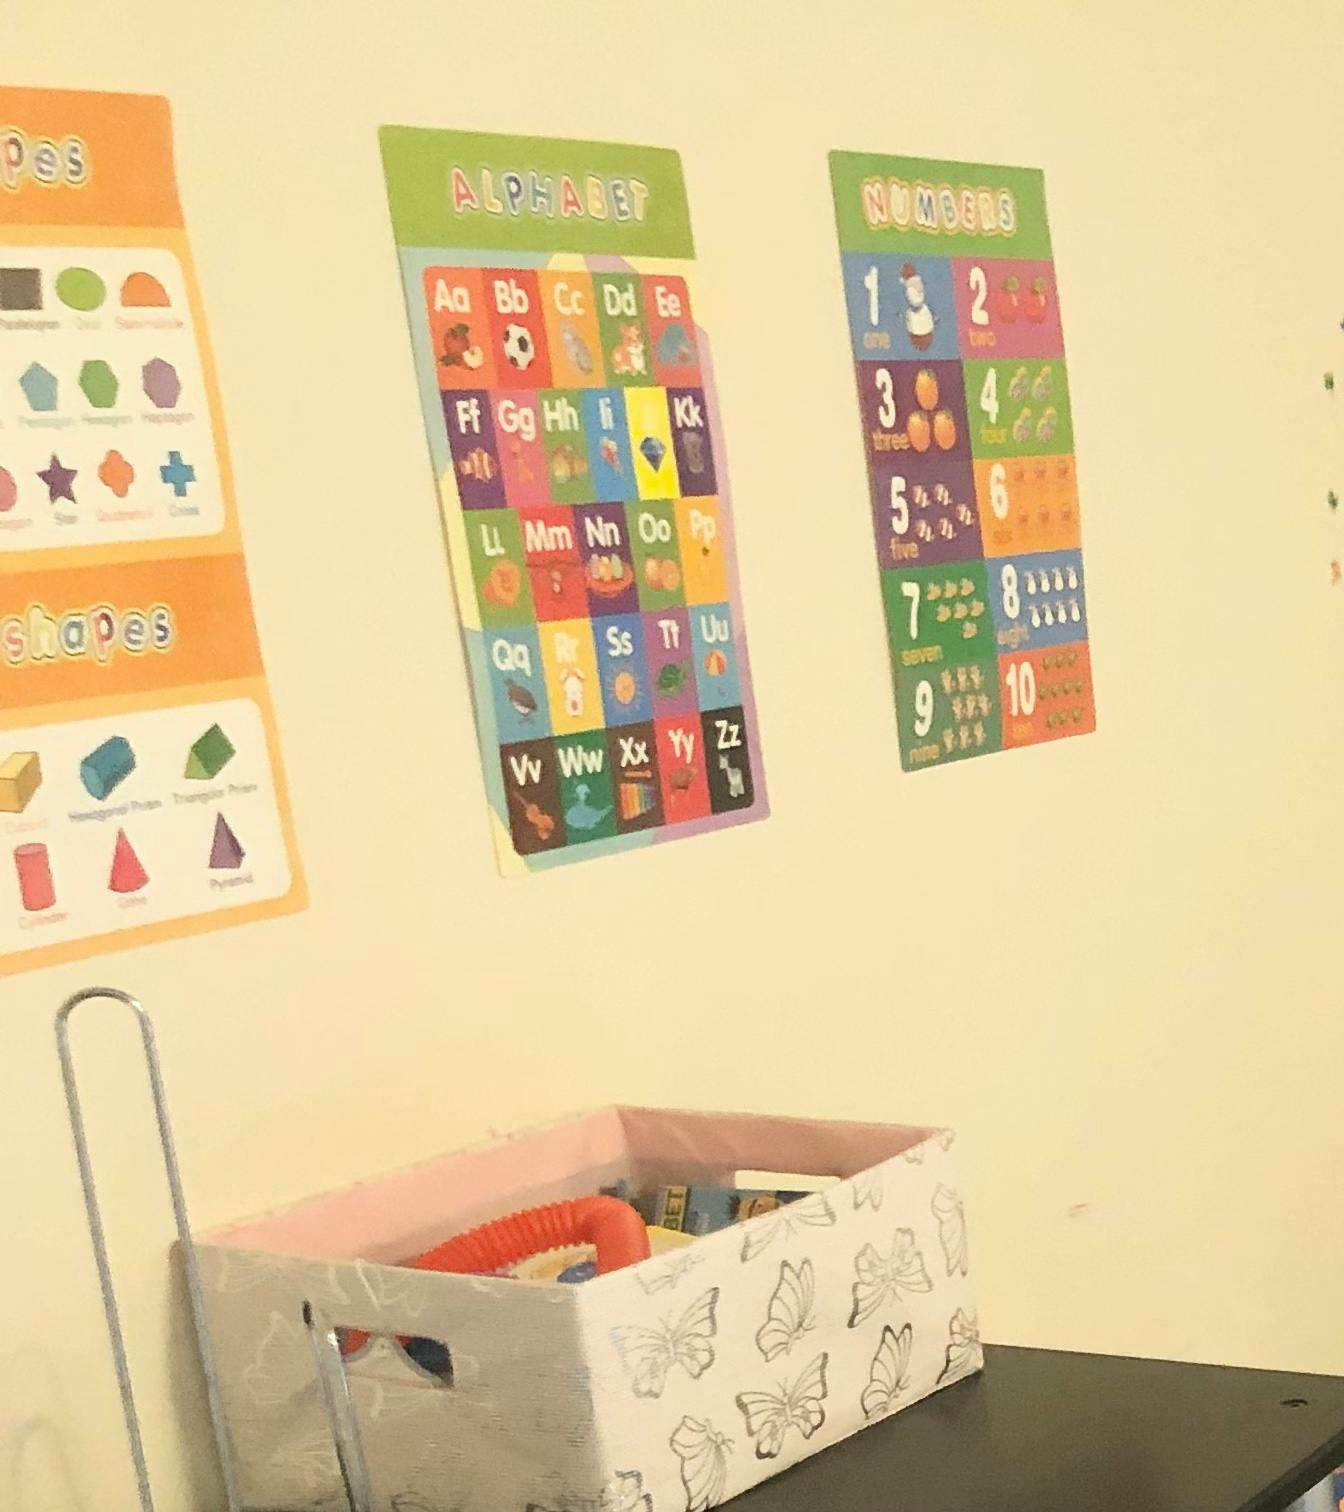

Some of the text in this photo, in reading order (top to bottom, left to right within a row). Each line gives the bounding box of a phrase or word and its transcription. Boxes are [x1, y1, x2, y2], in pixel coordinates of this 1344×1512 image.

[452, 167, 648, 221] ALPHABET
[863, 182, 1015, 232] NUMBERS
[434, 278, 681, 318] Aa Bb Cc Dd Ee
[864, 265, 879, 327] 1
[968, 266, 990, 326] 2
[456, 397, 481, 434] Ff
[498, 400, 536, 441] Gg
[541, 397, 580, 432] Hh
[674, 396, 704, 428] Kk
[875, 367, 896, 428] 3
[980, 367, 999, 424] 4
[890, 476, 909, 535] 5
[990, 463, 1009, 519] 6
[524, 520, 573, 552] Mm
[584, 516, 621, 548] Nn
[638, 512, 671, 543] Oo
[688, 508, 716, 544] Pp
[901, 582, 920, 640] 7
[1001, 564, 1020, 619] 8
[2, 605, 171, 661] shapes
[492, 639, 531, 676] Qq
[606, 625, 633, 657] Ss
[658, 619, 680, 649] Tt
[700, 614, 729, 643] Uu
[901, 646, 943, 666] seven
[915, 680, 933, 737] 9
[1006, 661, 1036, 717] 10
[510, 720, 742, 786] Vv Ww Xx Yy Zz
